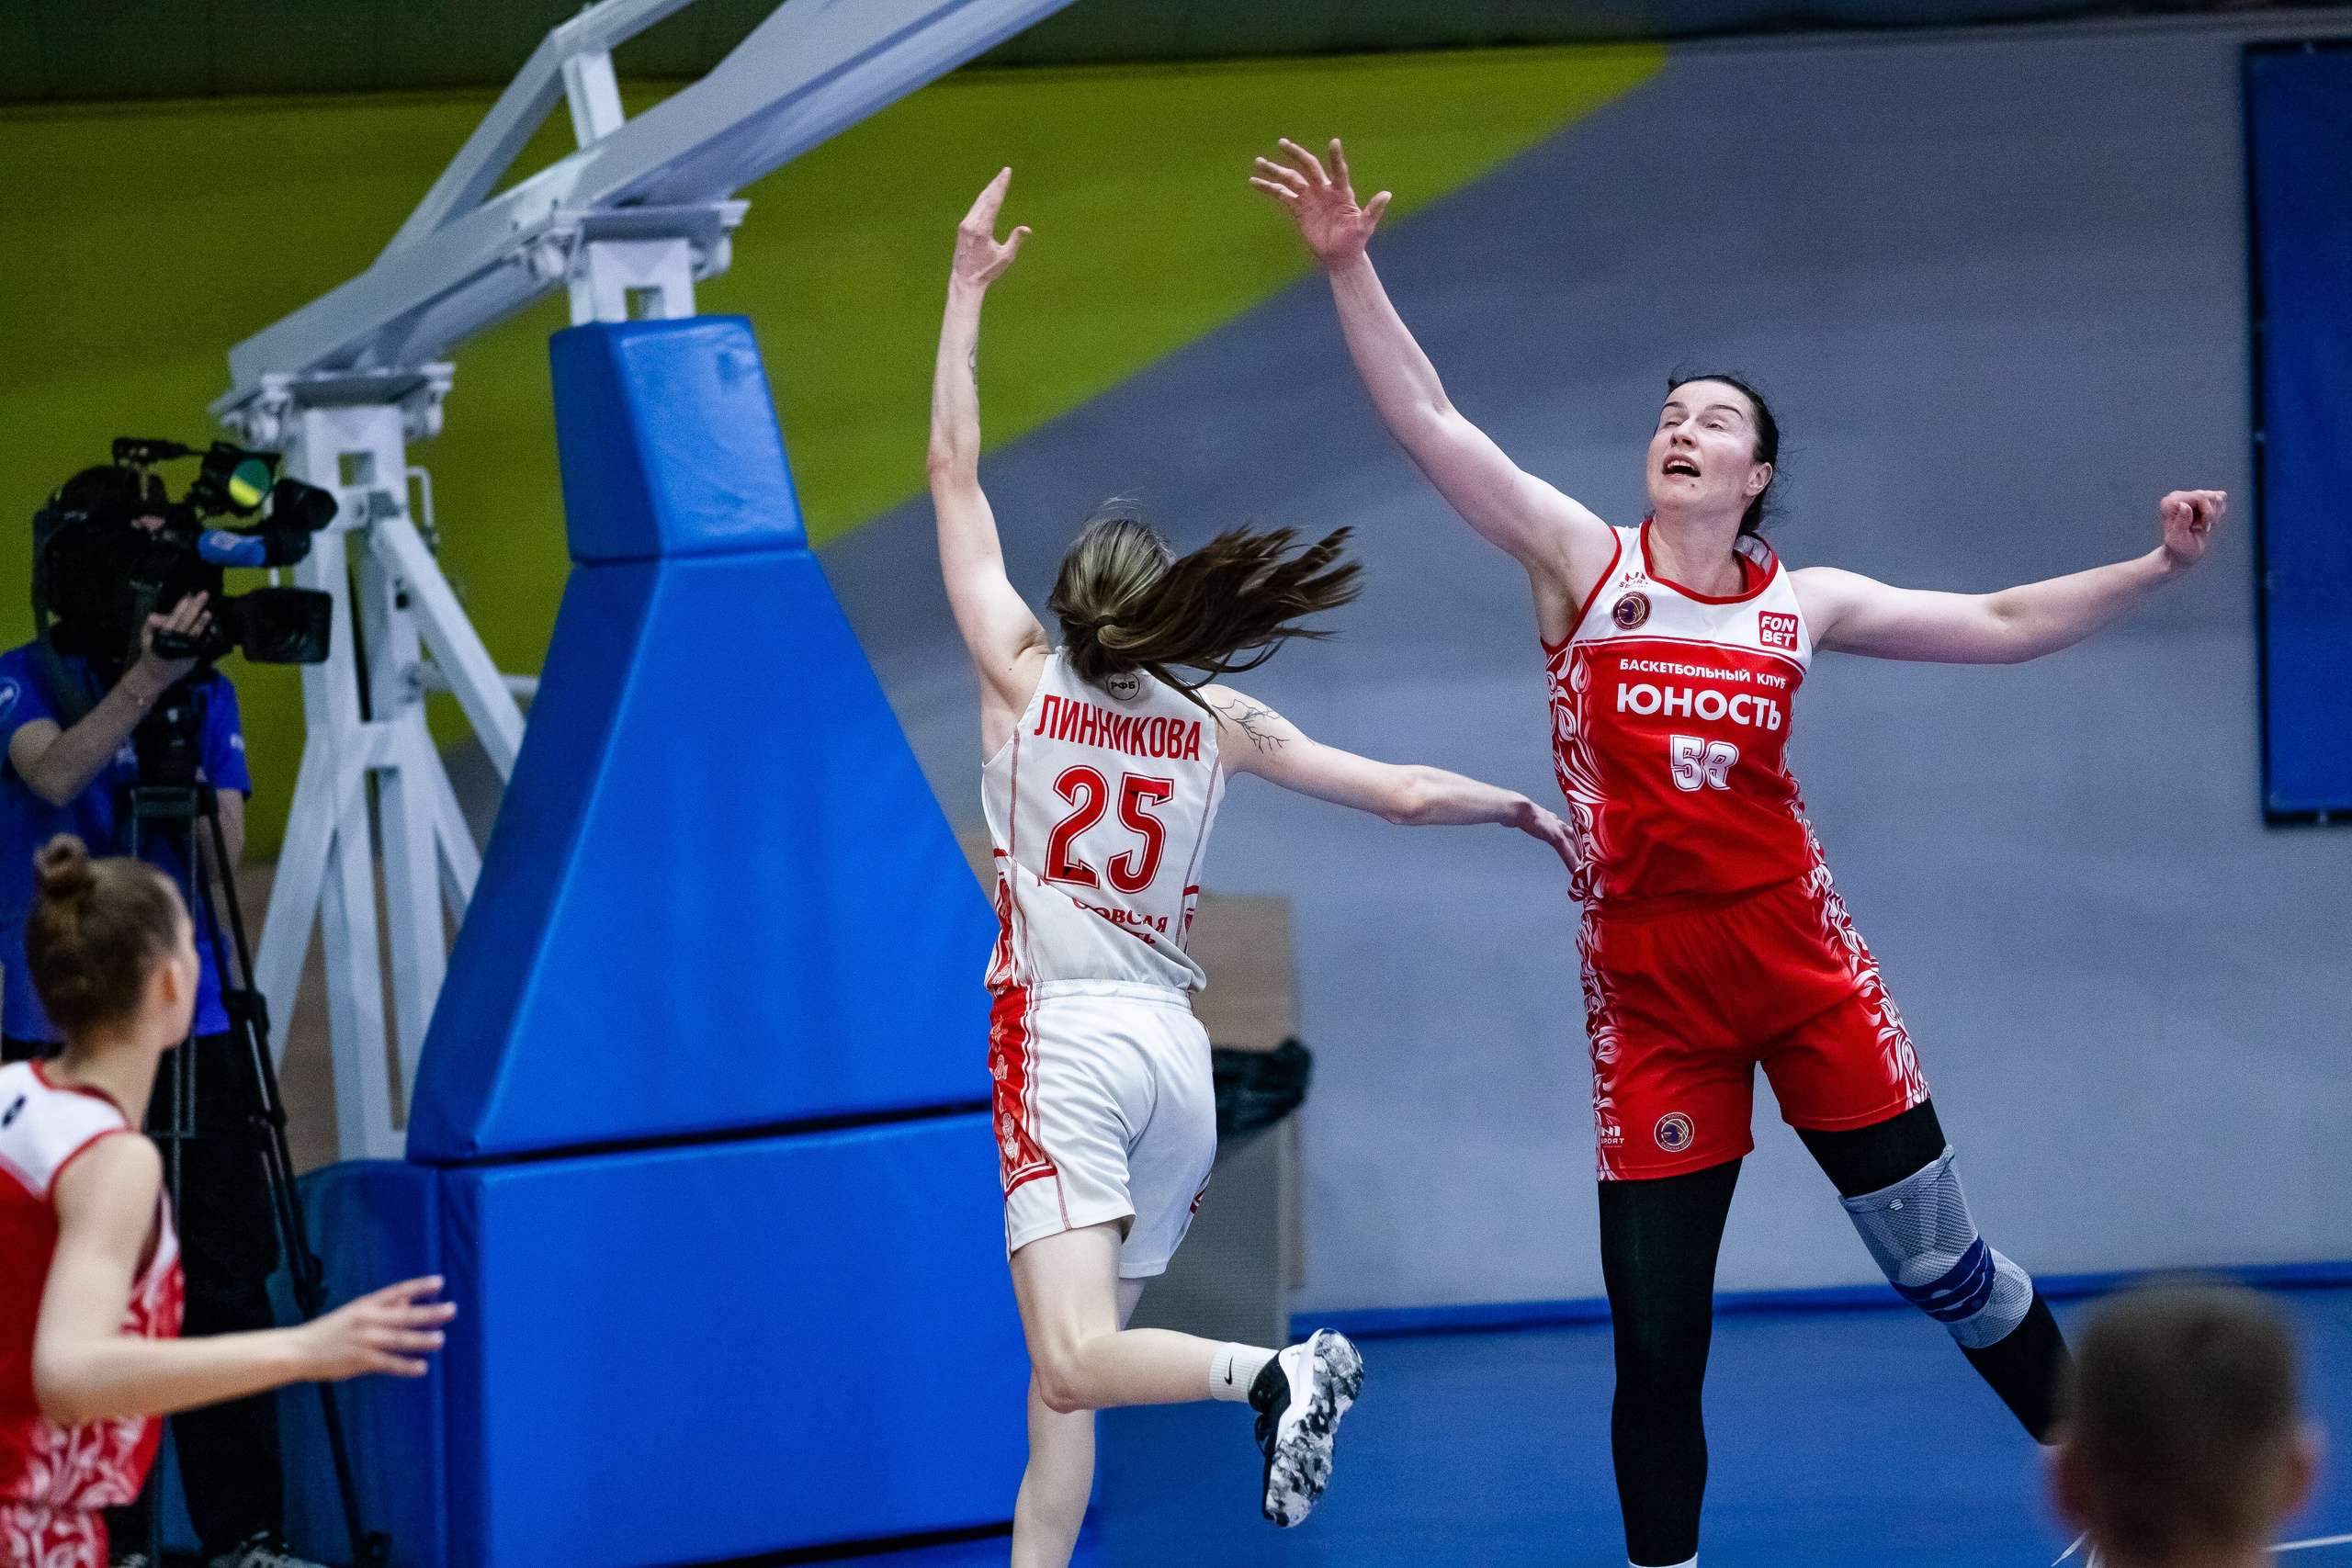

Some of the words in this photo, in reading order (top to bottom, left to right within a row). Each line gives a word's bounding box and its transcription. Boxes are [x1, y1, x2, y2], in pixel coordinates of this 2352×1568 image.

[1761, 615, 1795, 632] FON
[1762, 629, 1795, 647] BET
[1111, 681, 1136, 690] РФБ
[1620, 659, 1751, 682] БАСКЕТБОЛЬНЫЙ
[1757, 672, 1786, 689] КЛУБ
[1617, 683, 1781, 731] ЮНОСТЬ
[1035, 694, 1201, 761] ЛИННИКОВА
[1669, 735, 1739, 792] 58
[1045, 765, 1174, 894] 25
